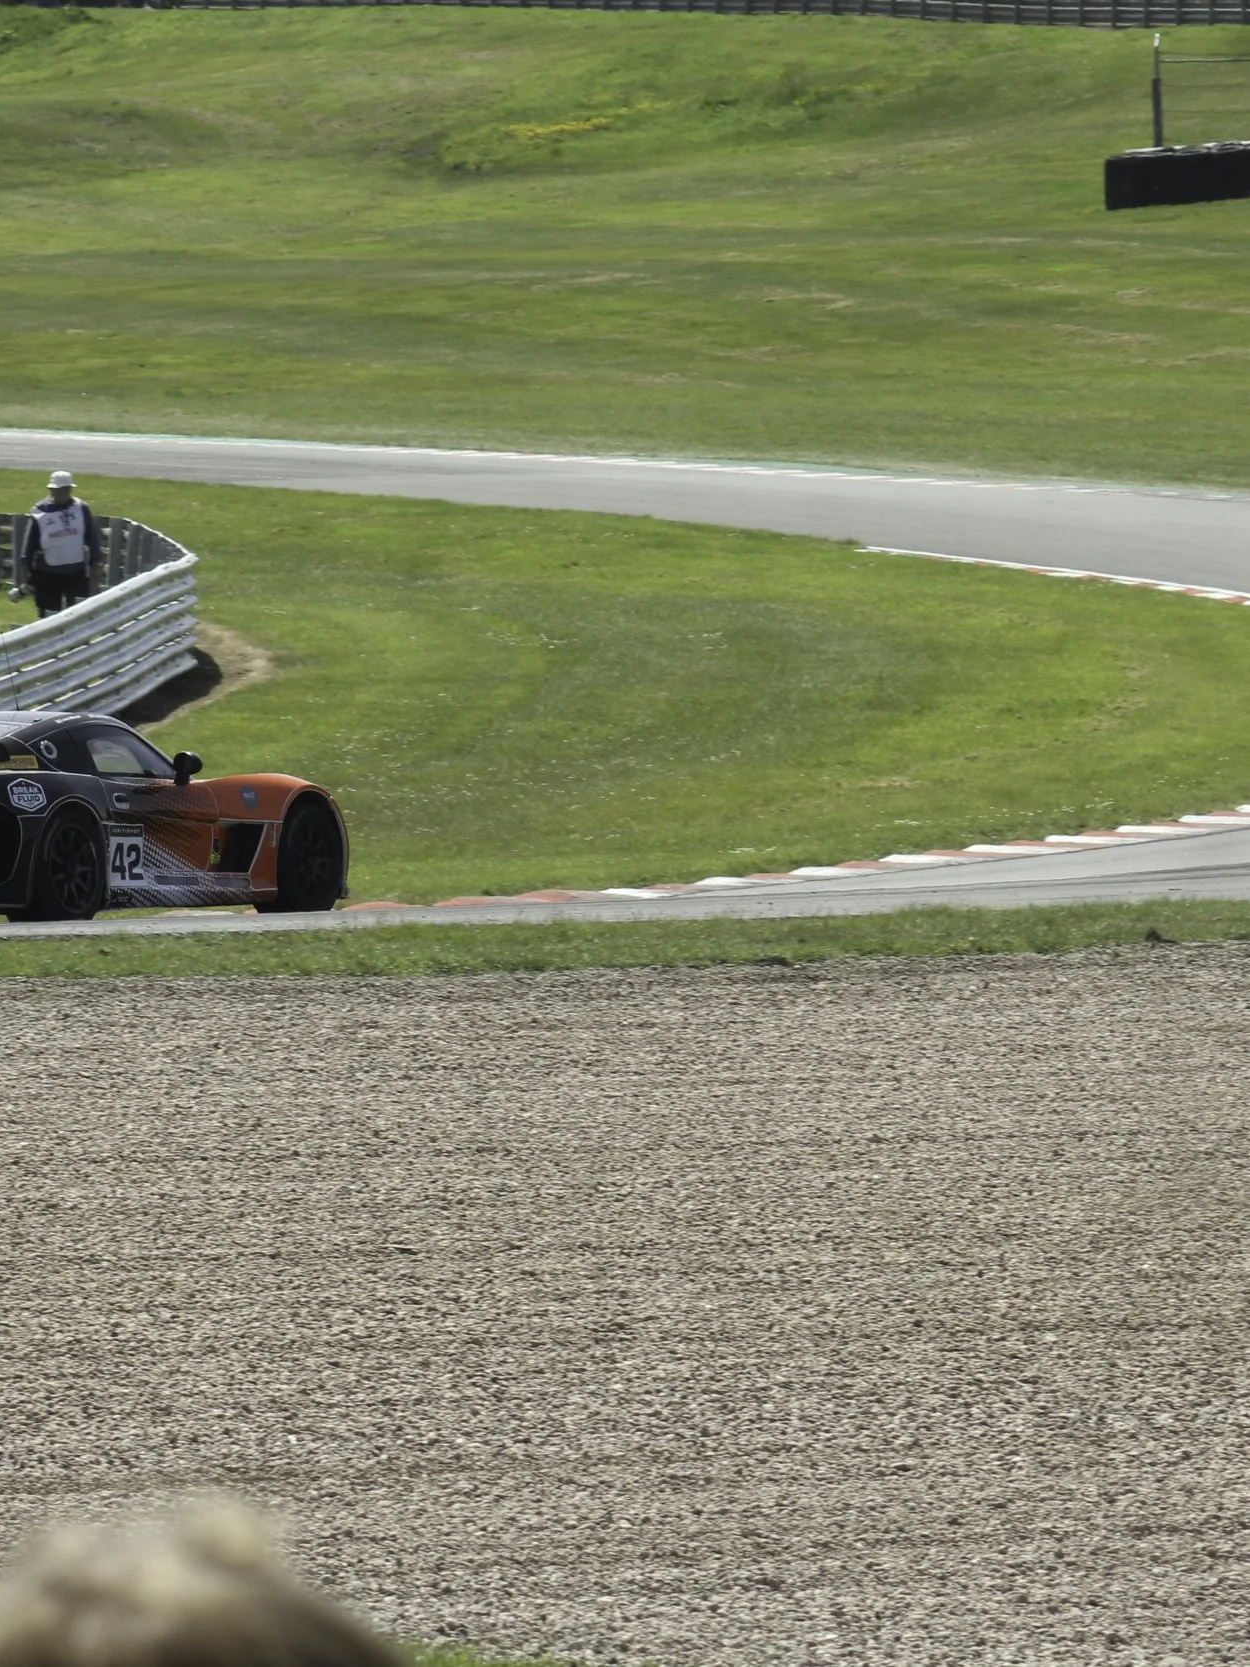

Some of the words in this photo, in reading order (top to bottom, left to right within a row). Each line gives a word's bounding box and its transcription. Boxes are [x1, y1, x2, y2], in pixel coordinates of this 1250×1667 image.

[12, 786, 40, 794] BREAK
[17, 794, 41, 803] FLUID
[111, 842, 145, 881] 42
